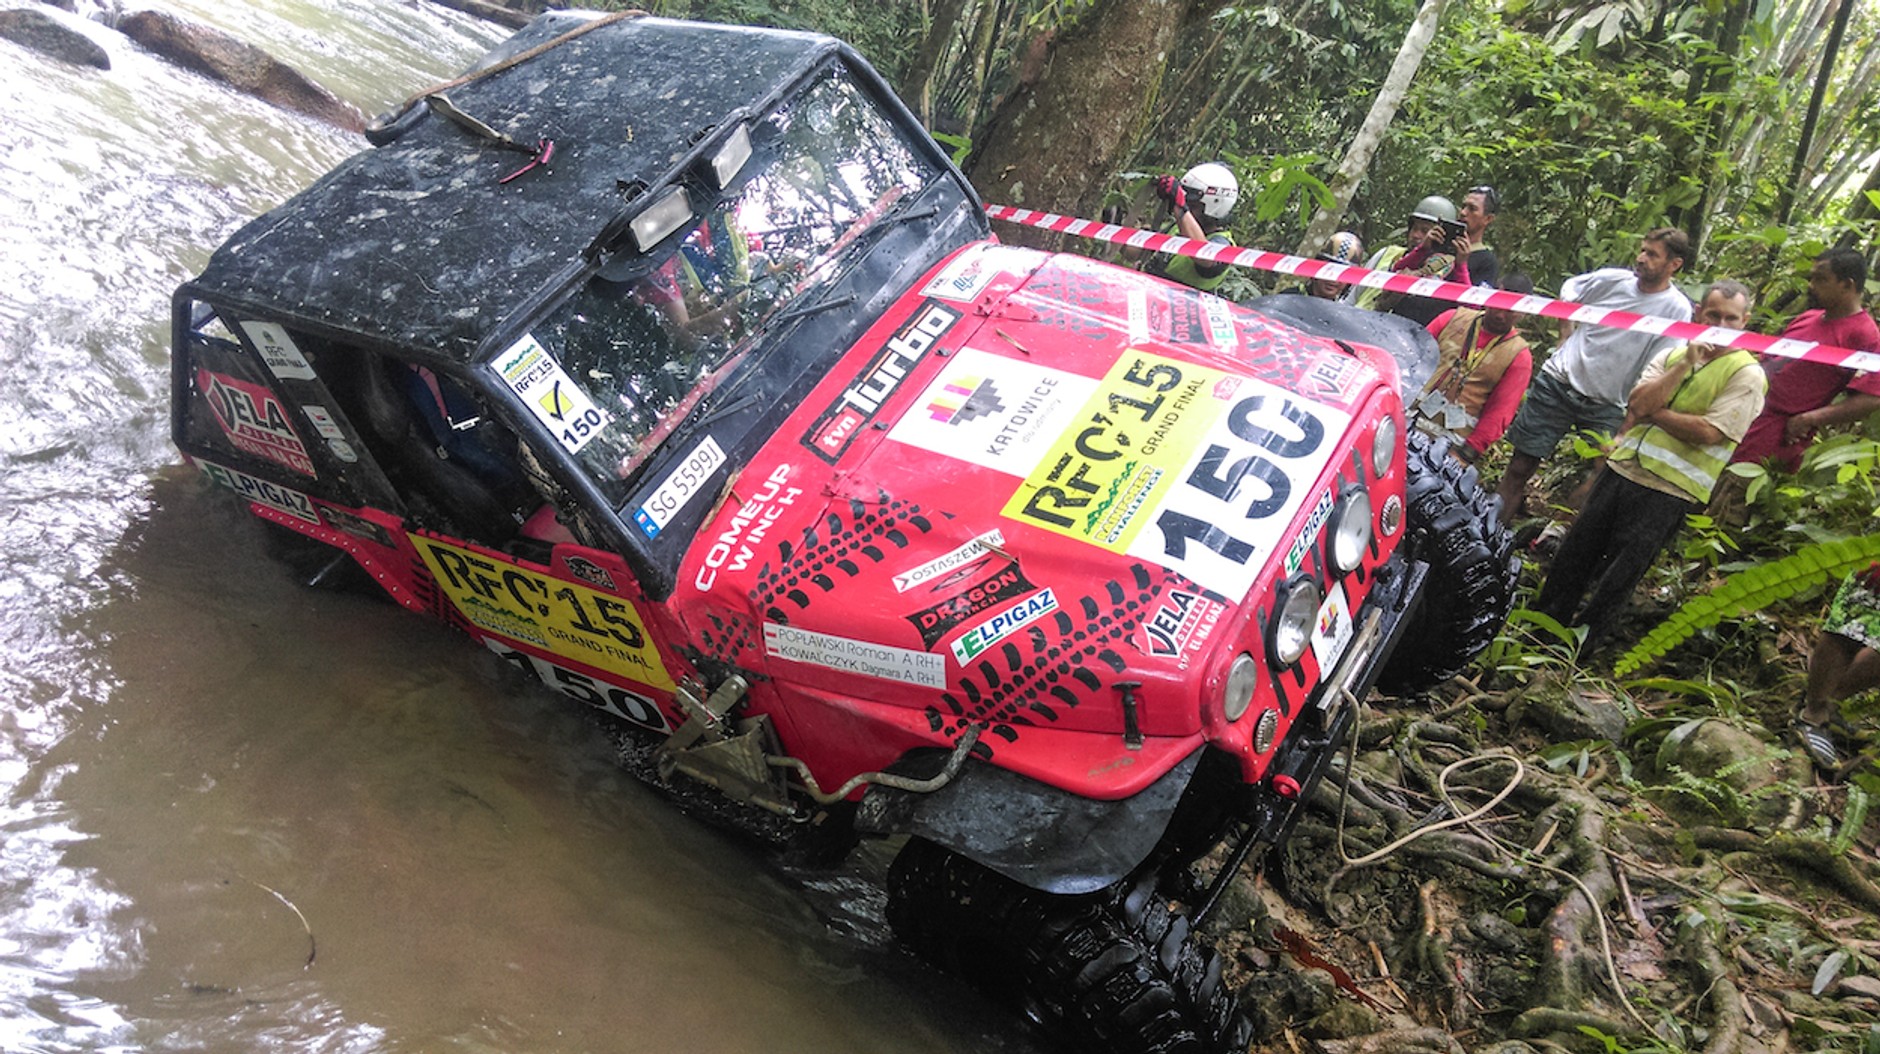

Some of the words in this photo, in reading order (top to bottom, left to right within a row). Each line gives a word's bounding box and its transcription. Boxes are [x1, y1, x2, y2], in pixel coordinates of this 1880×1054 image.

[834, 305, 955, 414] turbo
[1311, 353, 1351, 394] VELA
[563, 408, 602, 445] 150
[822, 415, 856, 448] tvn
[986, 377, 1059, 456] KATOWICE
[1021, 358, 1181, 530] RFC'15
[1143, 411, 1180, 456] GRAND
[1177, 378, 1206, 412] FINAL
[650, 490, 677, 520] SG
[672, 443, 719, 496] 5599J
[1107, 468, 1164, 544] CHALLENGE
[1156, 395, 1325, 566] 150
[694, 463, 791, 592] COMEUP
[1288, 491, 1332, 570] ELPIGAZ
[427, 544, 645, 649] RFC'15
[919, 570, 1018, 630] DRAGON
[953, 595, 998, 621] WINCH
[958, 590, 1055, 659] ELPIGAZ
[1145, 591, 1195, 656] VELA
[547, 626, 603, 653] GRAND
[607, 646, 654, 670] FINAL
[778, 628, 845, 652] POPŁAWSKI
[846, 641, 896, 663] Roman
[901, 653, 913, 666] A
[861, 661, 900, 679] Dagmara
[903, 669, 915, 682] A
[500, 650, 666, 730] 150
